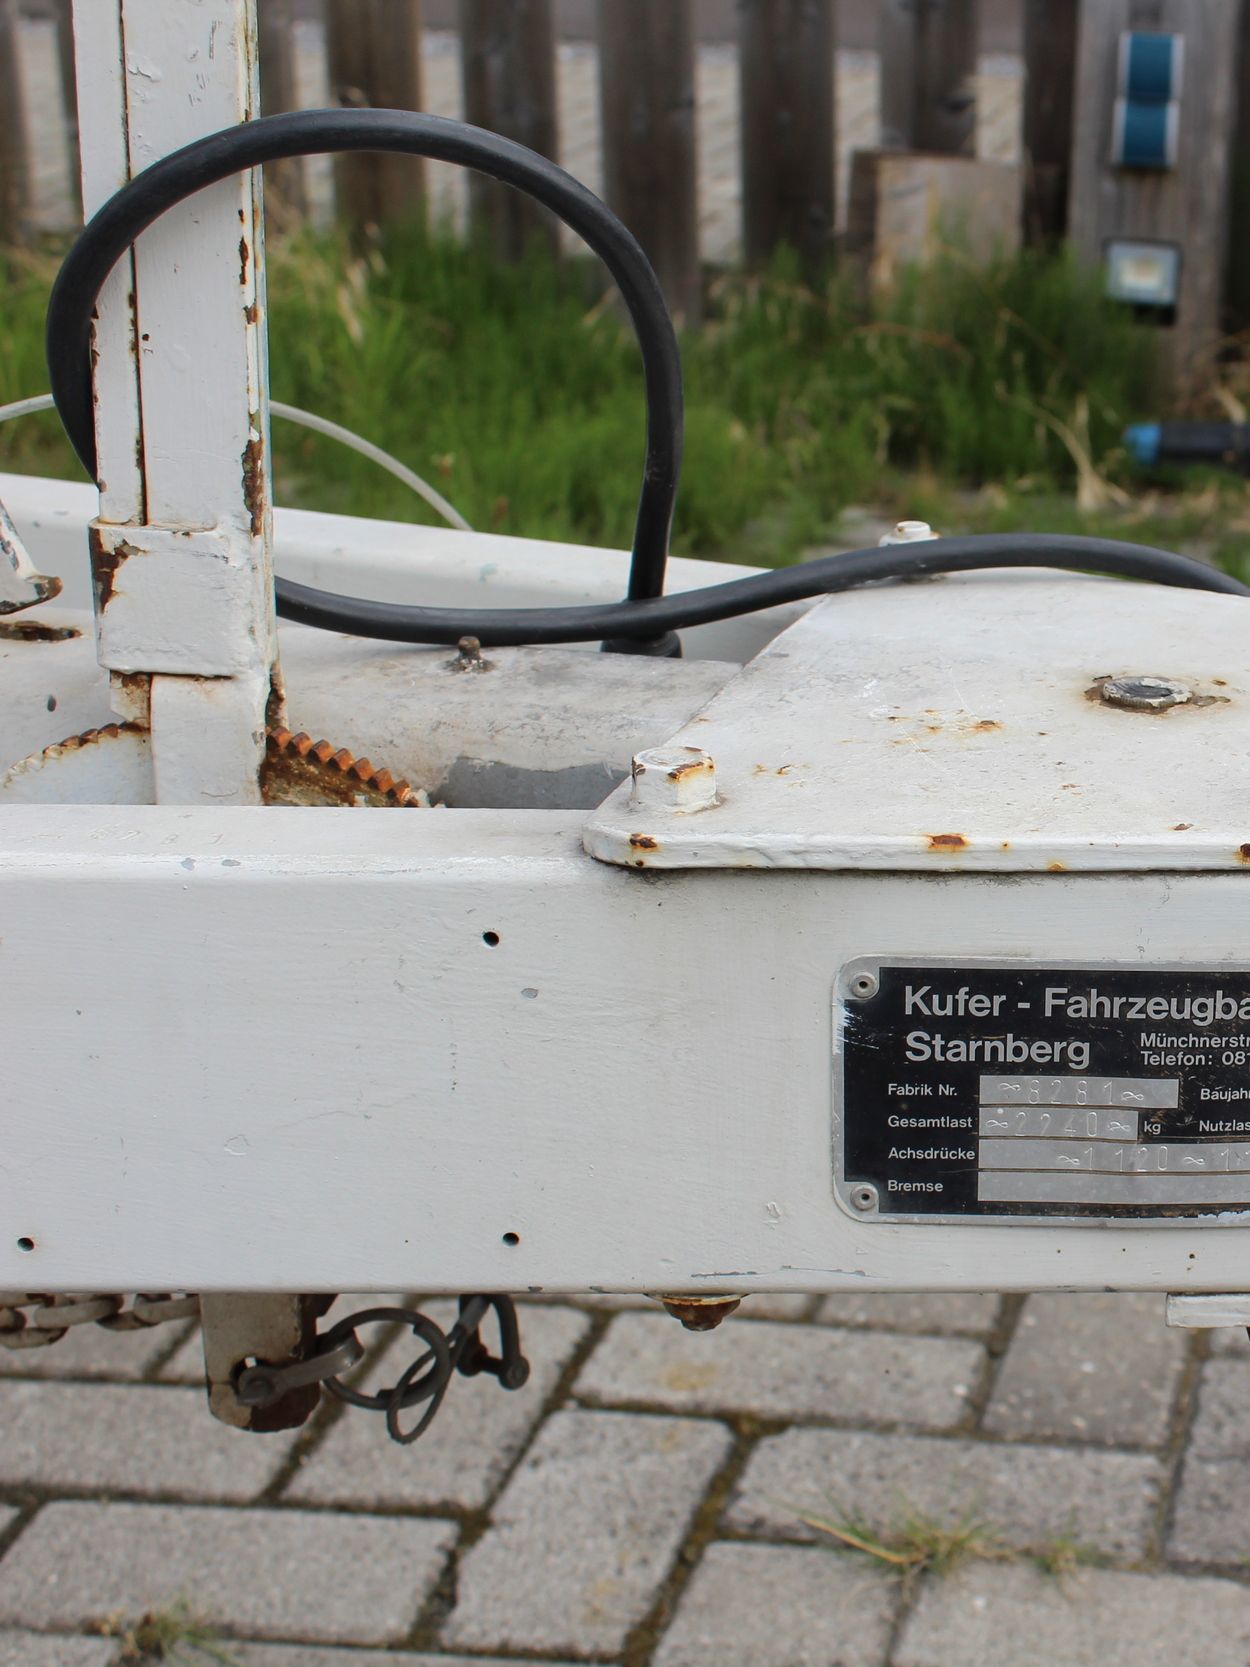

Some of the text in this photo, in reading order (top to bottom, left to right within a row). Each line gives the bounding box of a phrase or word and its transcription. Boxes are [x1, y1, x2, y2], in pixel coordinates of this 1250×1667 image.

[905, 985, 1006, 1017] Kufer
[905, 1030, 1090, 1070] Starnberg
[1140, 1051, 1213, 1066] Telefon:
[888, 1083, 958, 1096] Fabrik Nr.
[887, 1115, 973, 1128] Gesamtlast
[1144, 1121, 1162, 1135] kg
[887, 1147, 976, 1160] Achsdrücke
[887, 1180, 944, 1192] Bremse
